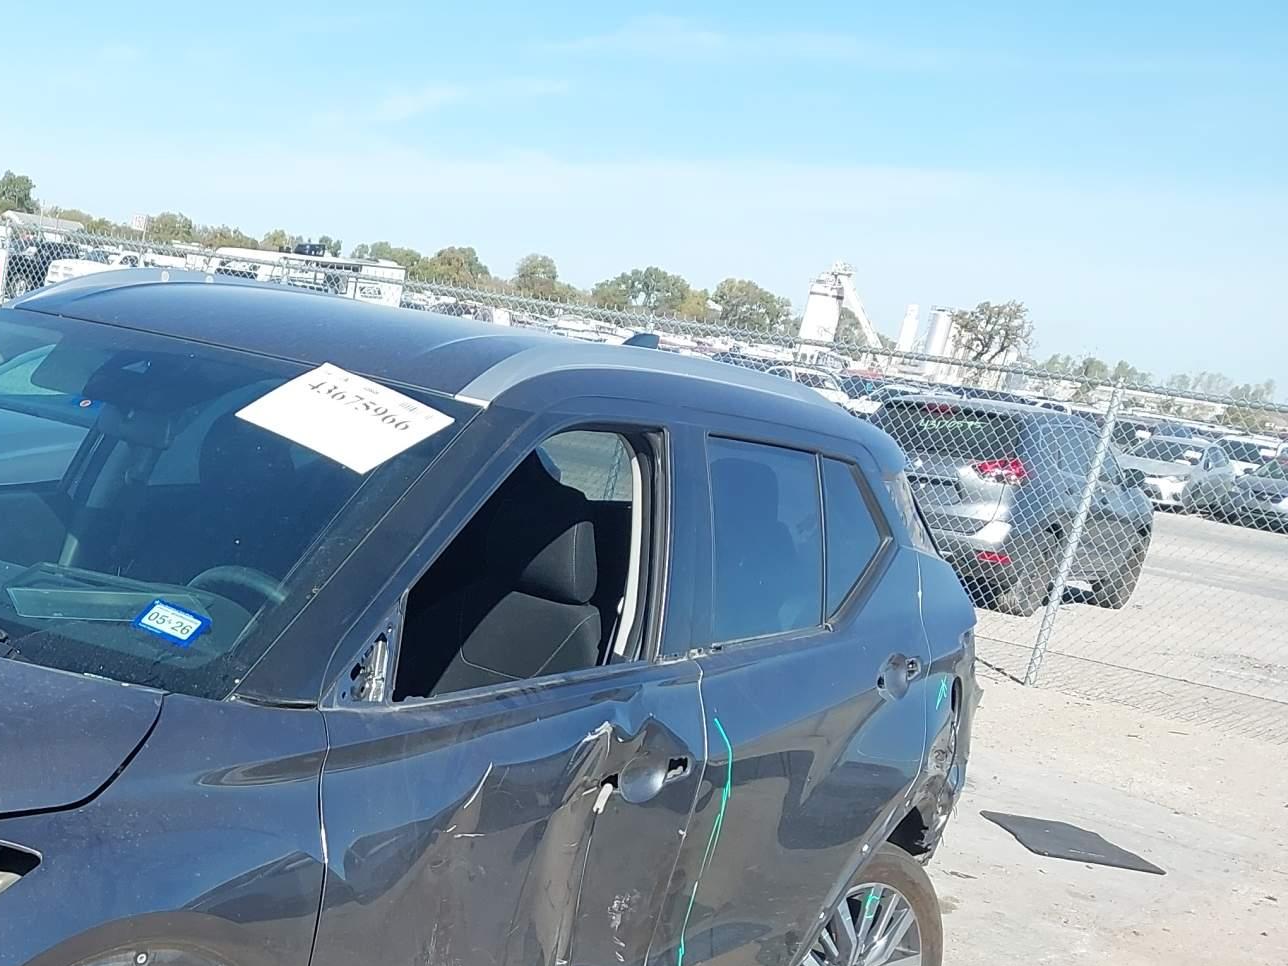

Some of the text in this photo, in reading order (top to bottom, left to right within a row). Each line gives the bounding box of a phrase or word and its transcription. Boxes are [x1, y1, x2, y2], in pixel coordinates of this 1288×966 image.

[307, 380, 412, 431] 43675966
[147, 611, 169, 625] 05
[171, 620, 193, 635] 26
